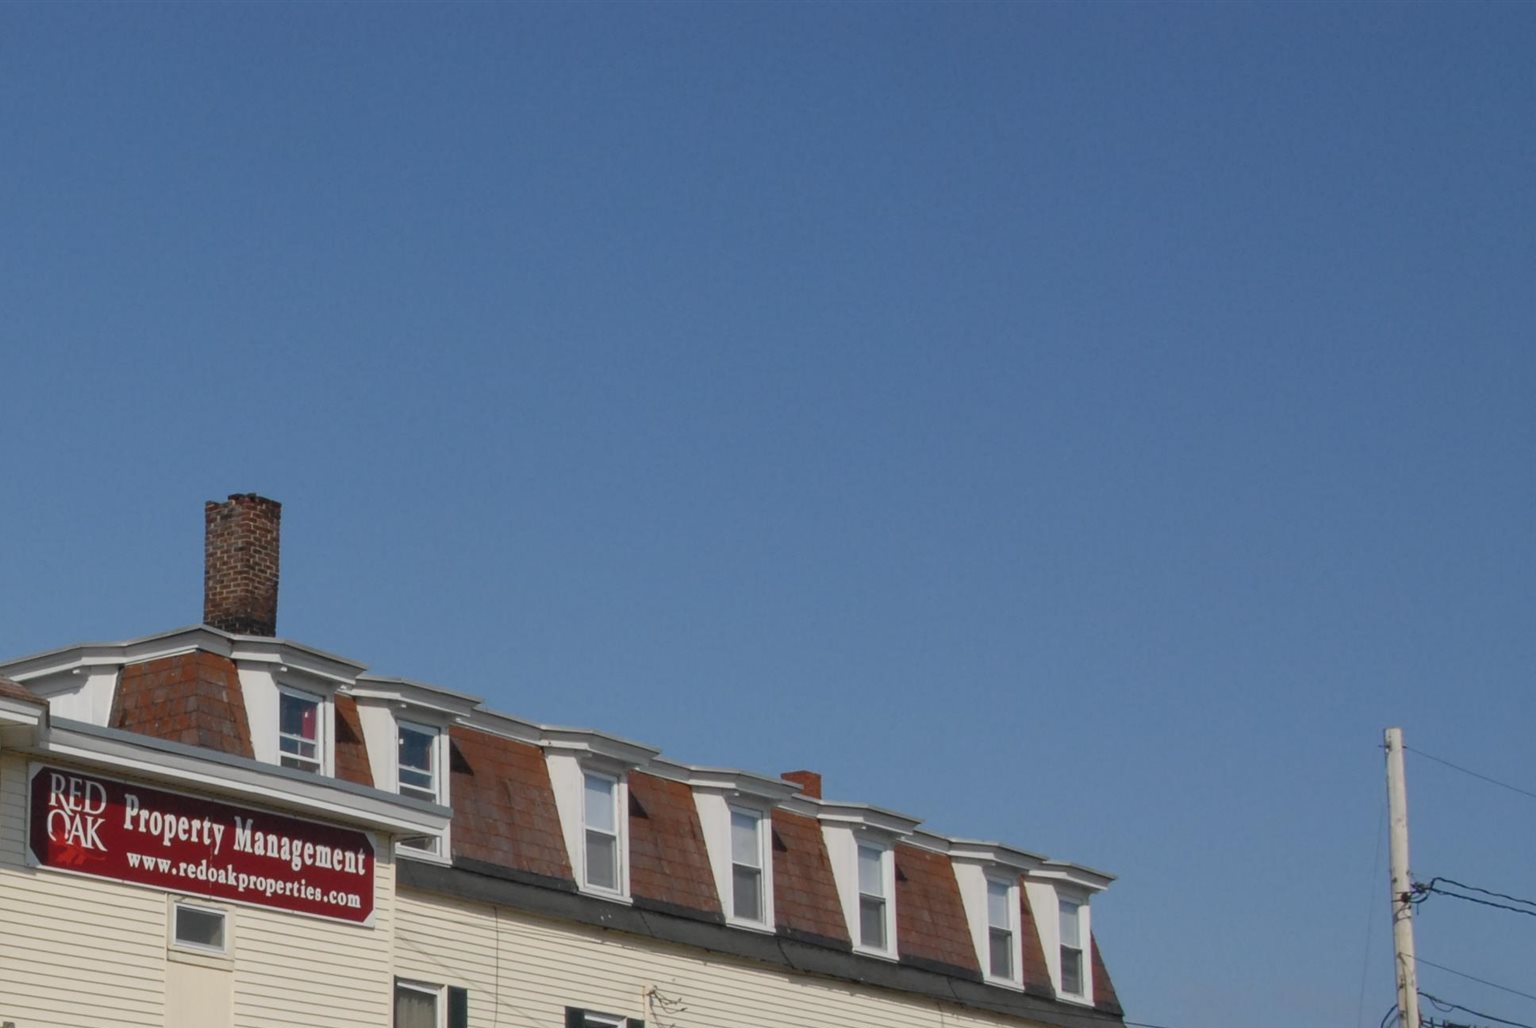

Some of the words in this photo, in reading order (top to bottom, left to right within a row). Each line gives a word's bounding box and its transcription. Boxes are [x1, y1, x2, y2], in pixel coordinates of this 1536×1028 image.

[48, 773, 107, 816] RED
[47, 809, 108, 852] OAK
[124, 793, 224, 855] Property
[233, 816, 366, 876] Management
[126, 852, 361, 908] www.redoakproperties.com
